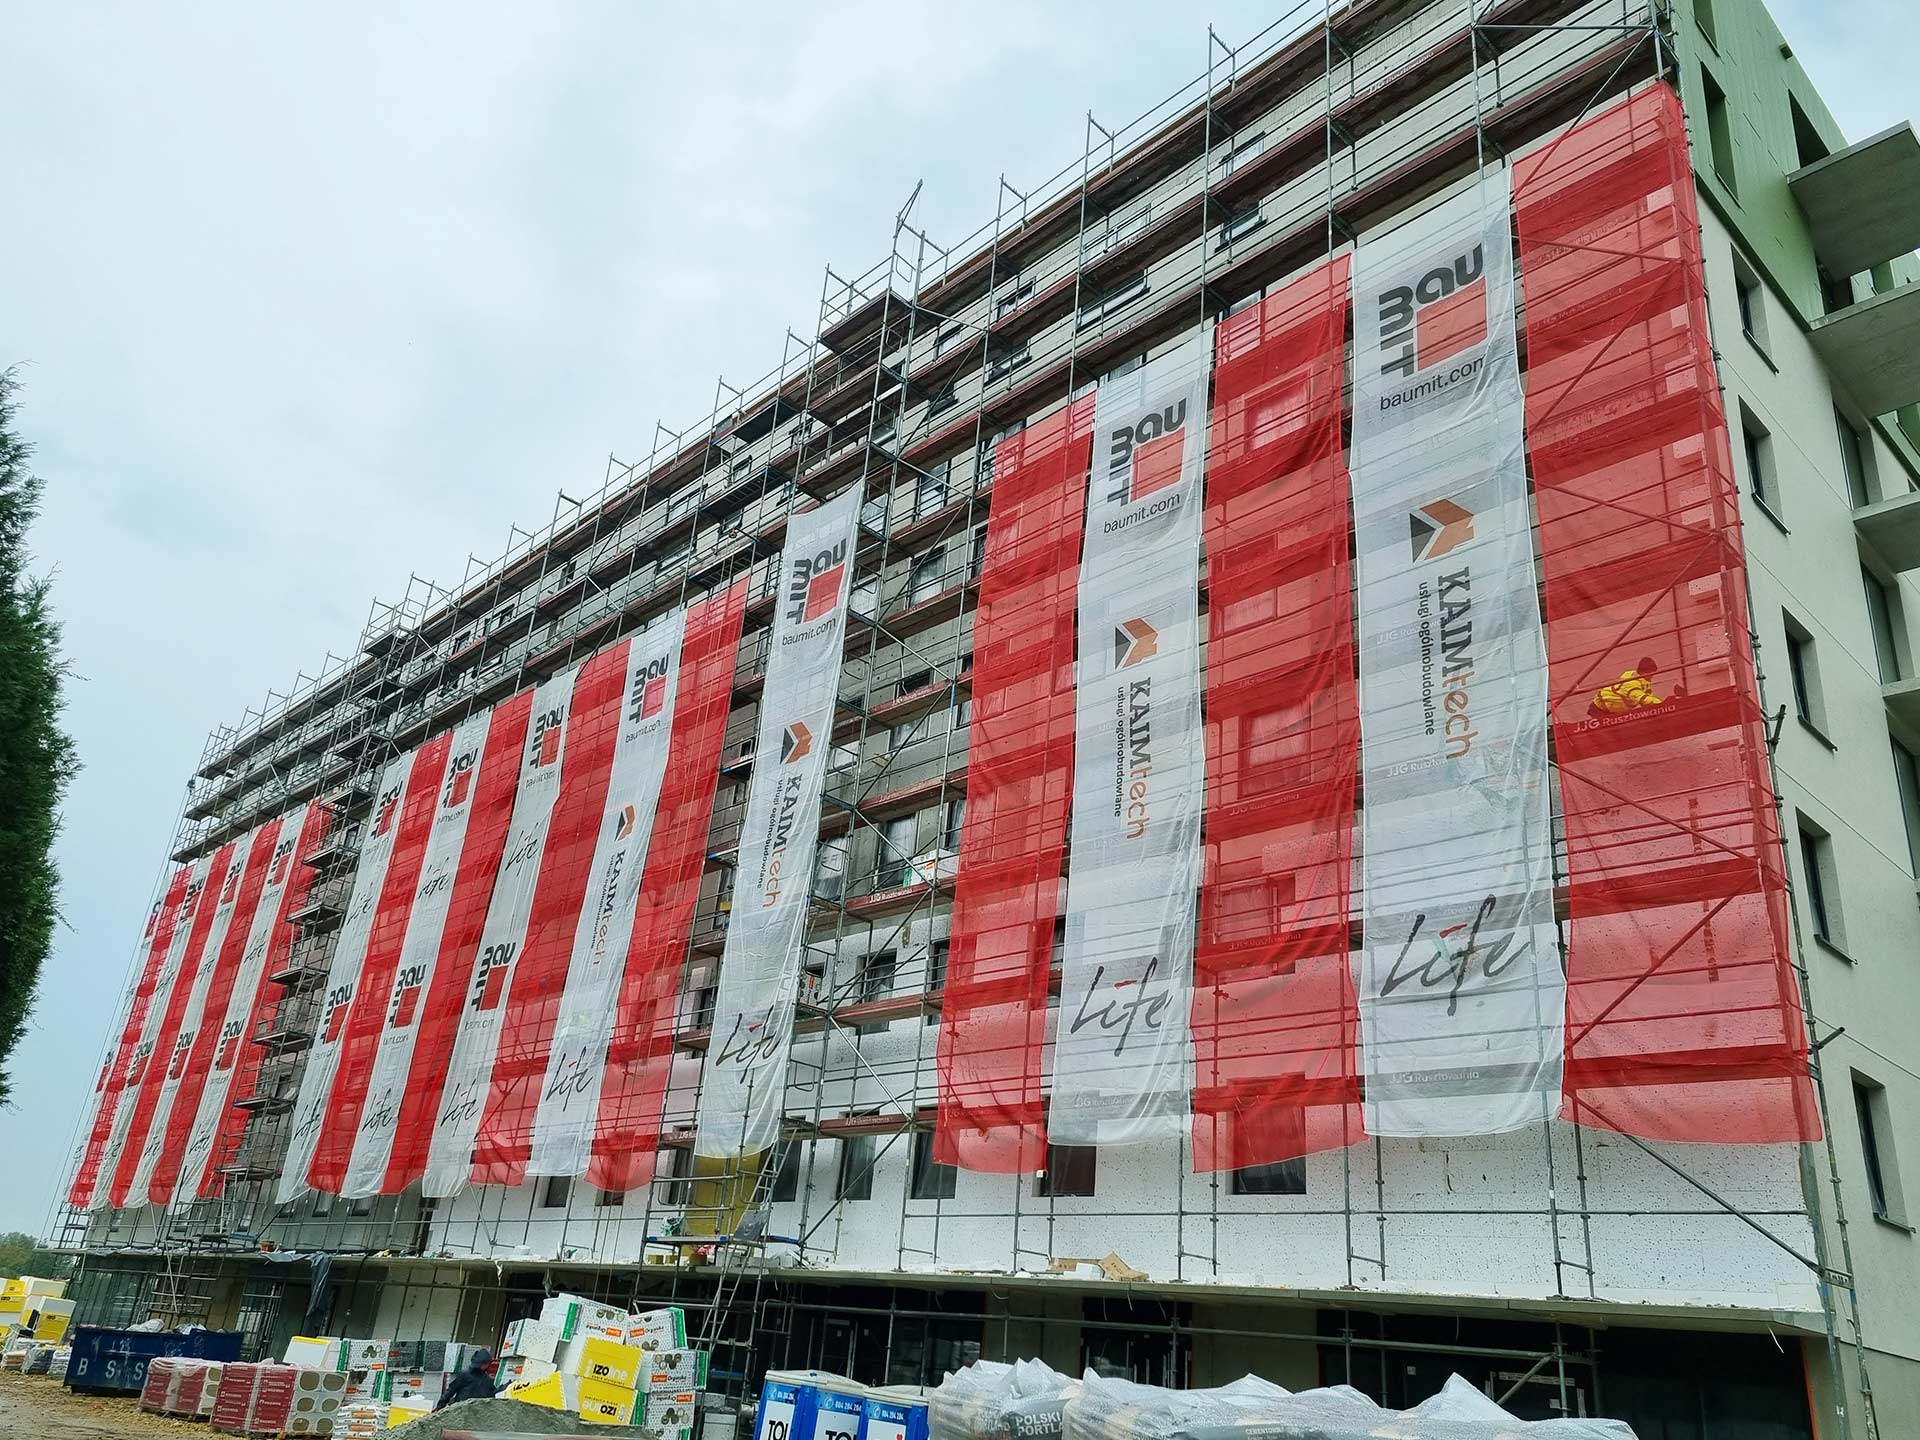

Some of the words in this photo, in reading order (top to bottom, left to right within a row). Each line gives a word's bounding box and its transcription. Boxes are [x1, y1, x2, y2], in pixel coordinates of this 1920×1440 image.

[1104, 494, 1180, 534] baumit.com
[782, 618, 836, 646] baumit.com
[1602, 703, 1676, 726] Rusztowania
[1380, 894, 1531, 1016] Life
[1071, 956, 1173, 1057] Life
[1015, 1411, 1061, 1426] POLSKI
